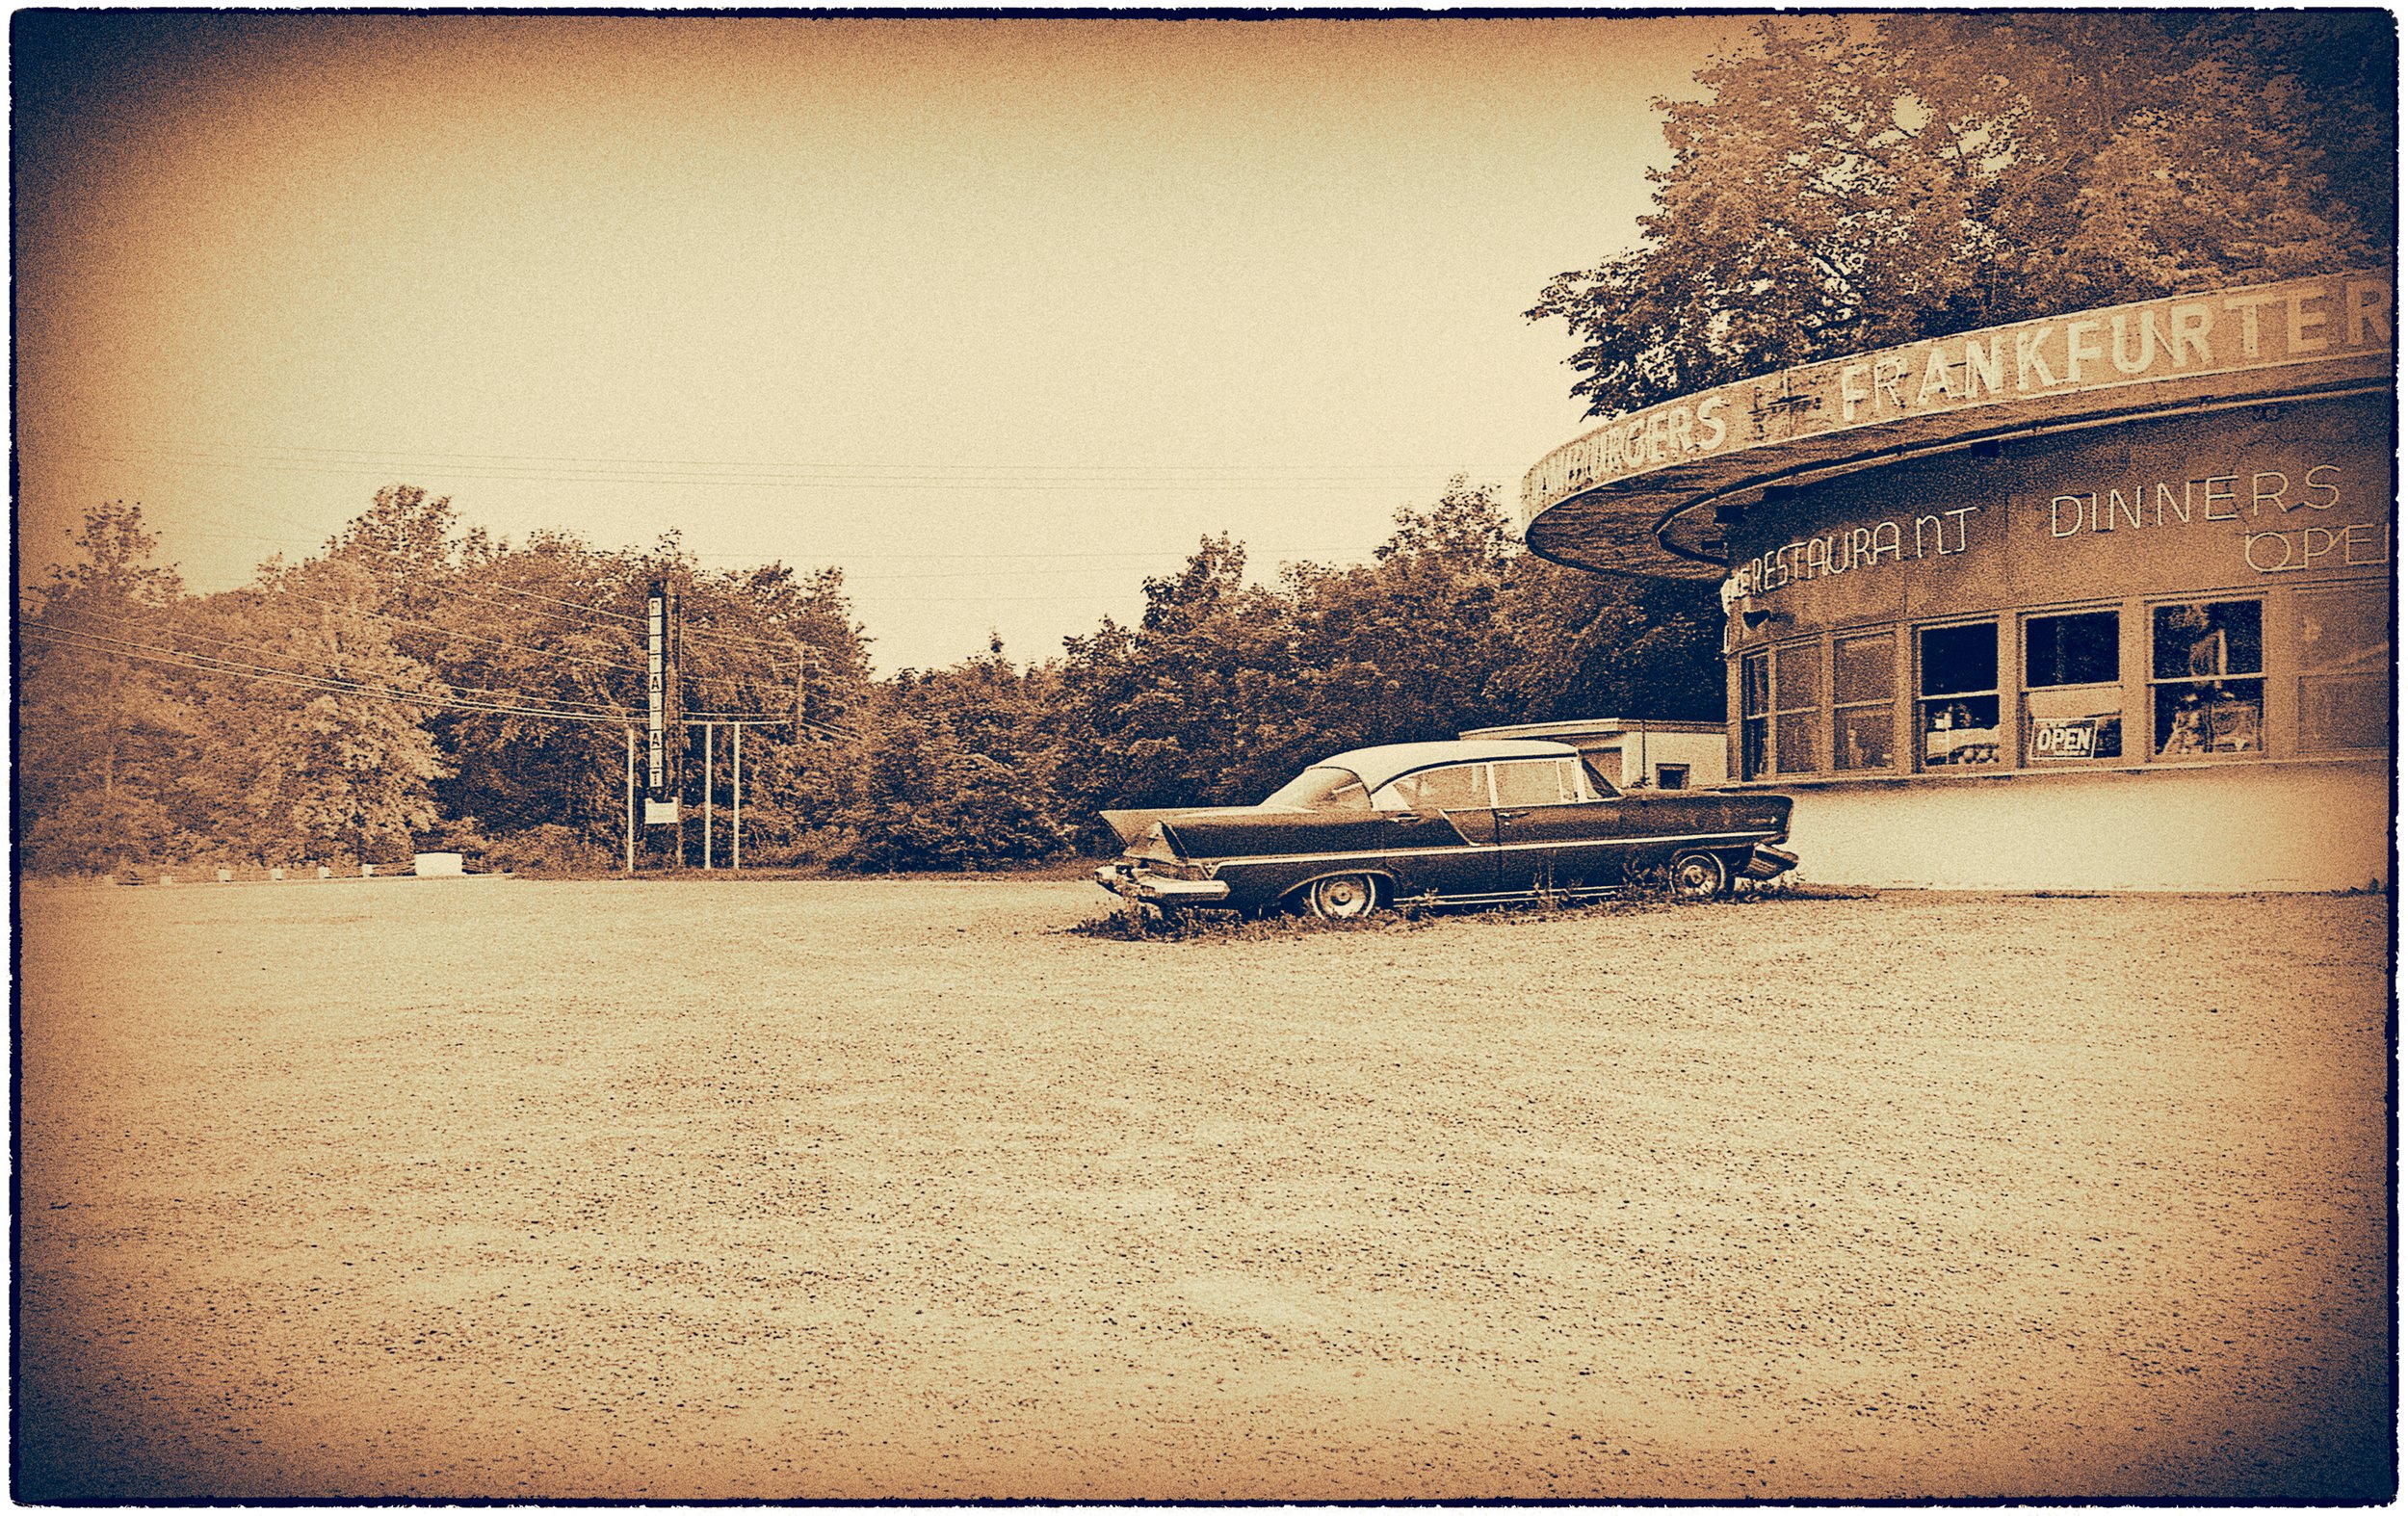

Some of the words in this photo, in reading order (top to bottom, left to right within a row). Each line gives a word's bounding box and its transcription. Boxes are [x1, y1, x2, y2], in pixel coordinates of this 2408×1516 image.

[1842, 280, 2392, 421] FRANKFURTER
[2050, 464, 2342, 539] DINNERS
[2245, 523, 2390, 573] OPE
[2037, 727, 2092, 751] OPEN
